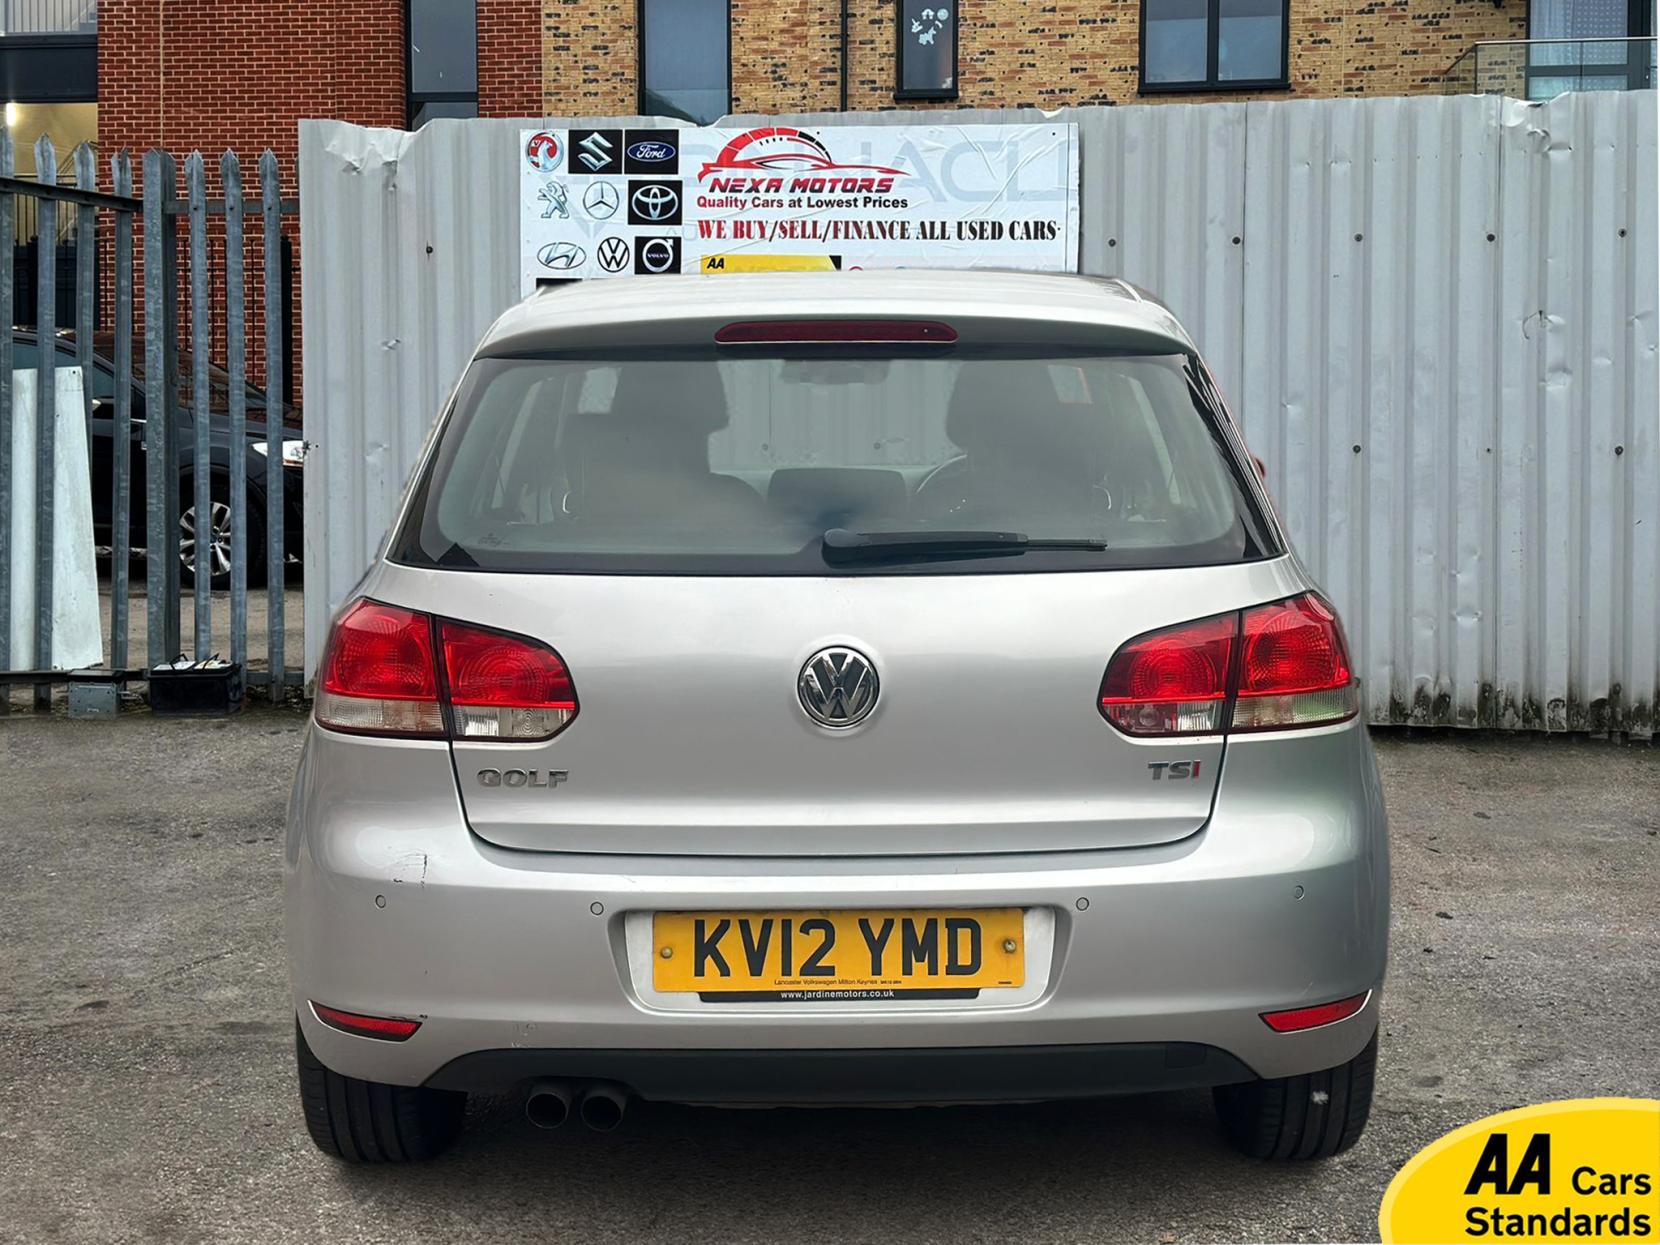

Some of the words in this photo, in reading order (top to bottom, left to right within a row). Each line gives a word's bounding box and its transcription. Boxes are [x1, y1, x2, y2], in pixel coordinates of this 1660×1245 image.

[637, 144, 666, 158] Ford
[708, 177, 784, 193] NEXA
[789, 177, 895, 194] MOTORS
[697, 195, 747, 210] Quality
[751, 196, 784, 208] Cars
[788, 196, 802, 208] at
[807, 196, 859, 208] Lowest
[863, 196, 908, 208] Prices
[697, 219, 726, 240] WE
[733, 219, 910, 243] BUY/SELL/FINANCE
[916, 221, 951, 241] ALL
[957, 220, 1003, 241] USED
[707, 257, 725, 269] AA
[476, 768, 569, 789] GOLF
[693, 918, 836, 977] KV12
[857, 918, 982, 976] YMD
[803, 979, 837, 987] Volkswagen
[857, 979, 878, 987] Keynes
[780, 989, 895, 1000] www.jardinemotors.co.uk
